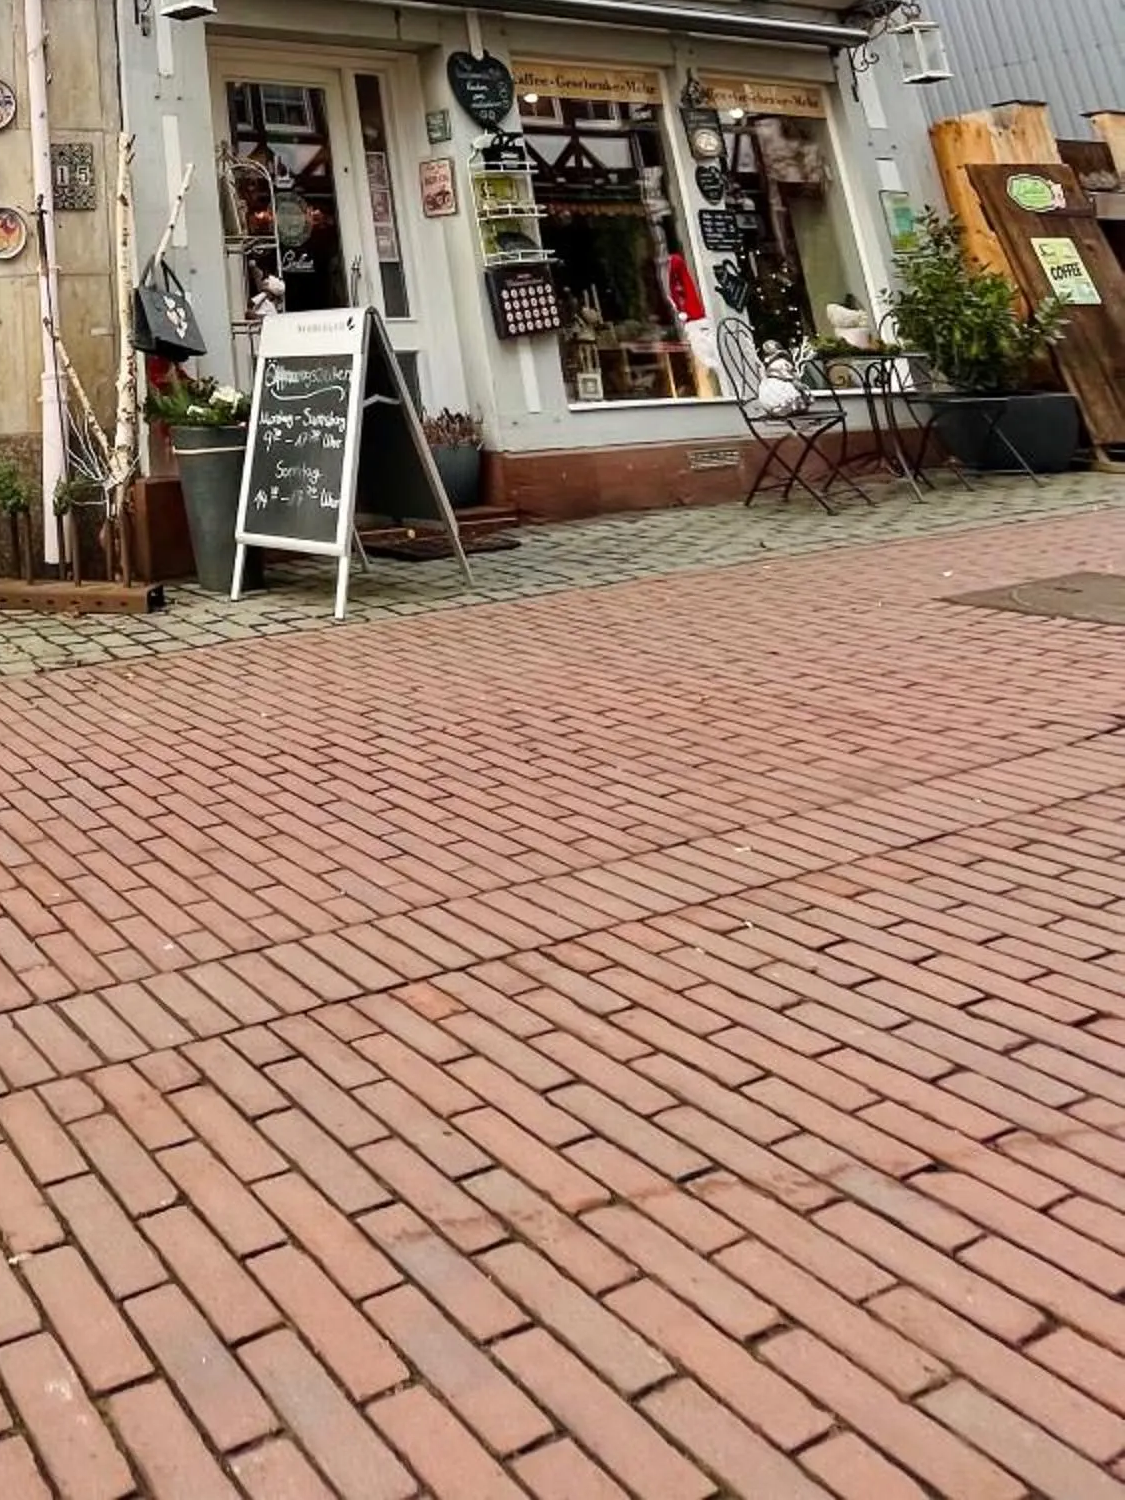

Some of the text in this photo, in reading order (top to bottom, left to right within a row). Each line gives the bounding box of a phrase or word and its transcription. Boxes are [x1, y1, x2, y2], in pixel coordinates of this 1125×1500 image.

[513, 72, 546, 86] affee
[57, 166, 89, 183] 15
[1050, 261, 1083, 281] COFFEE
